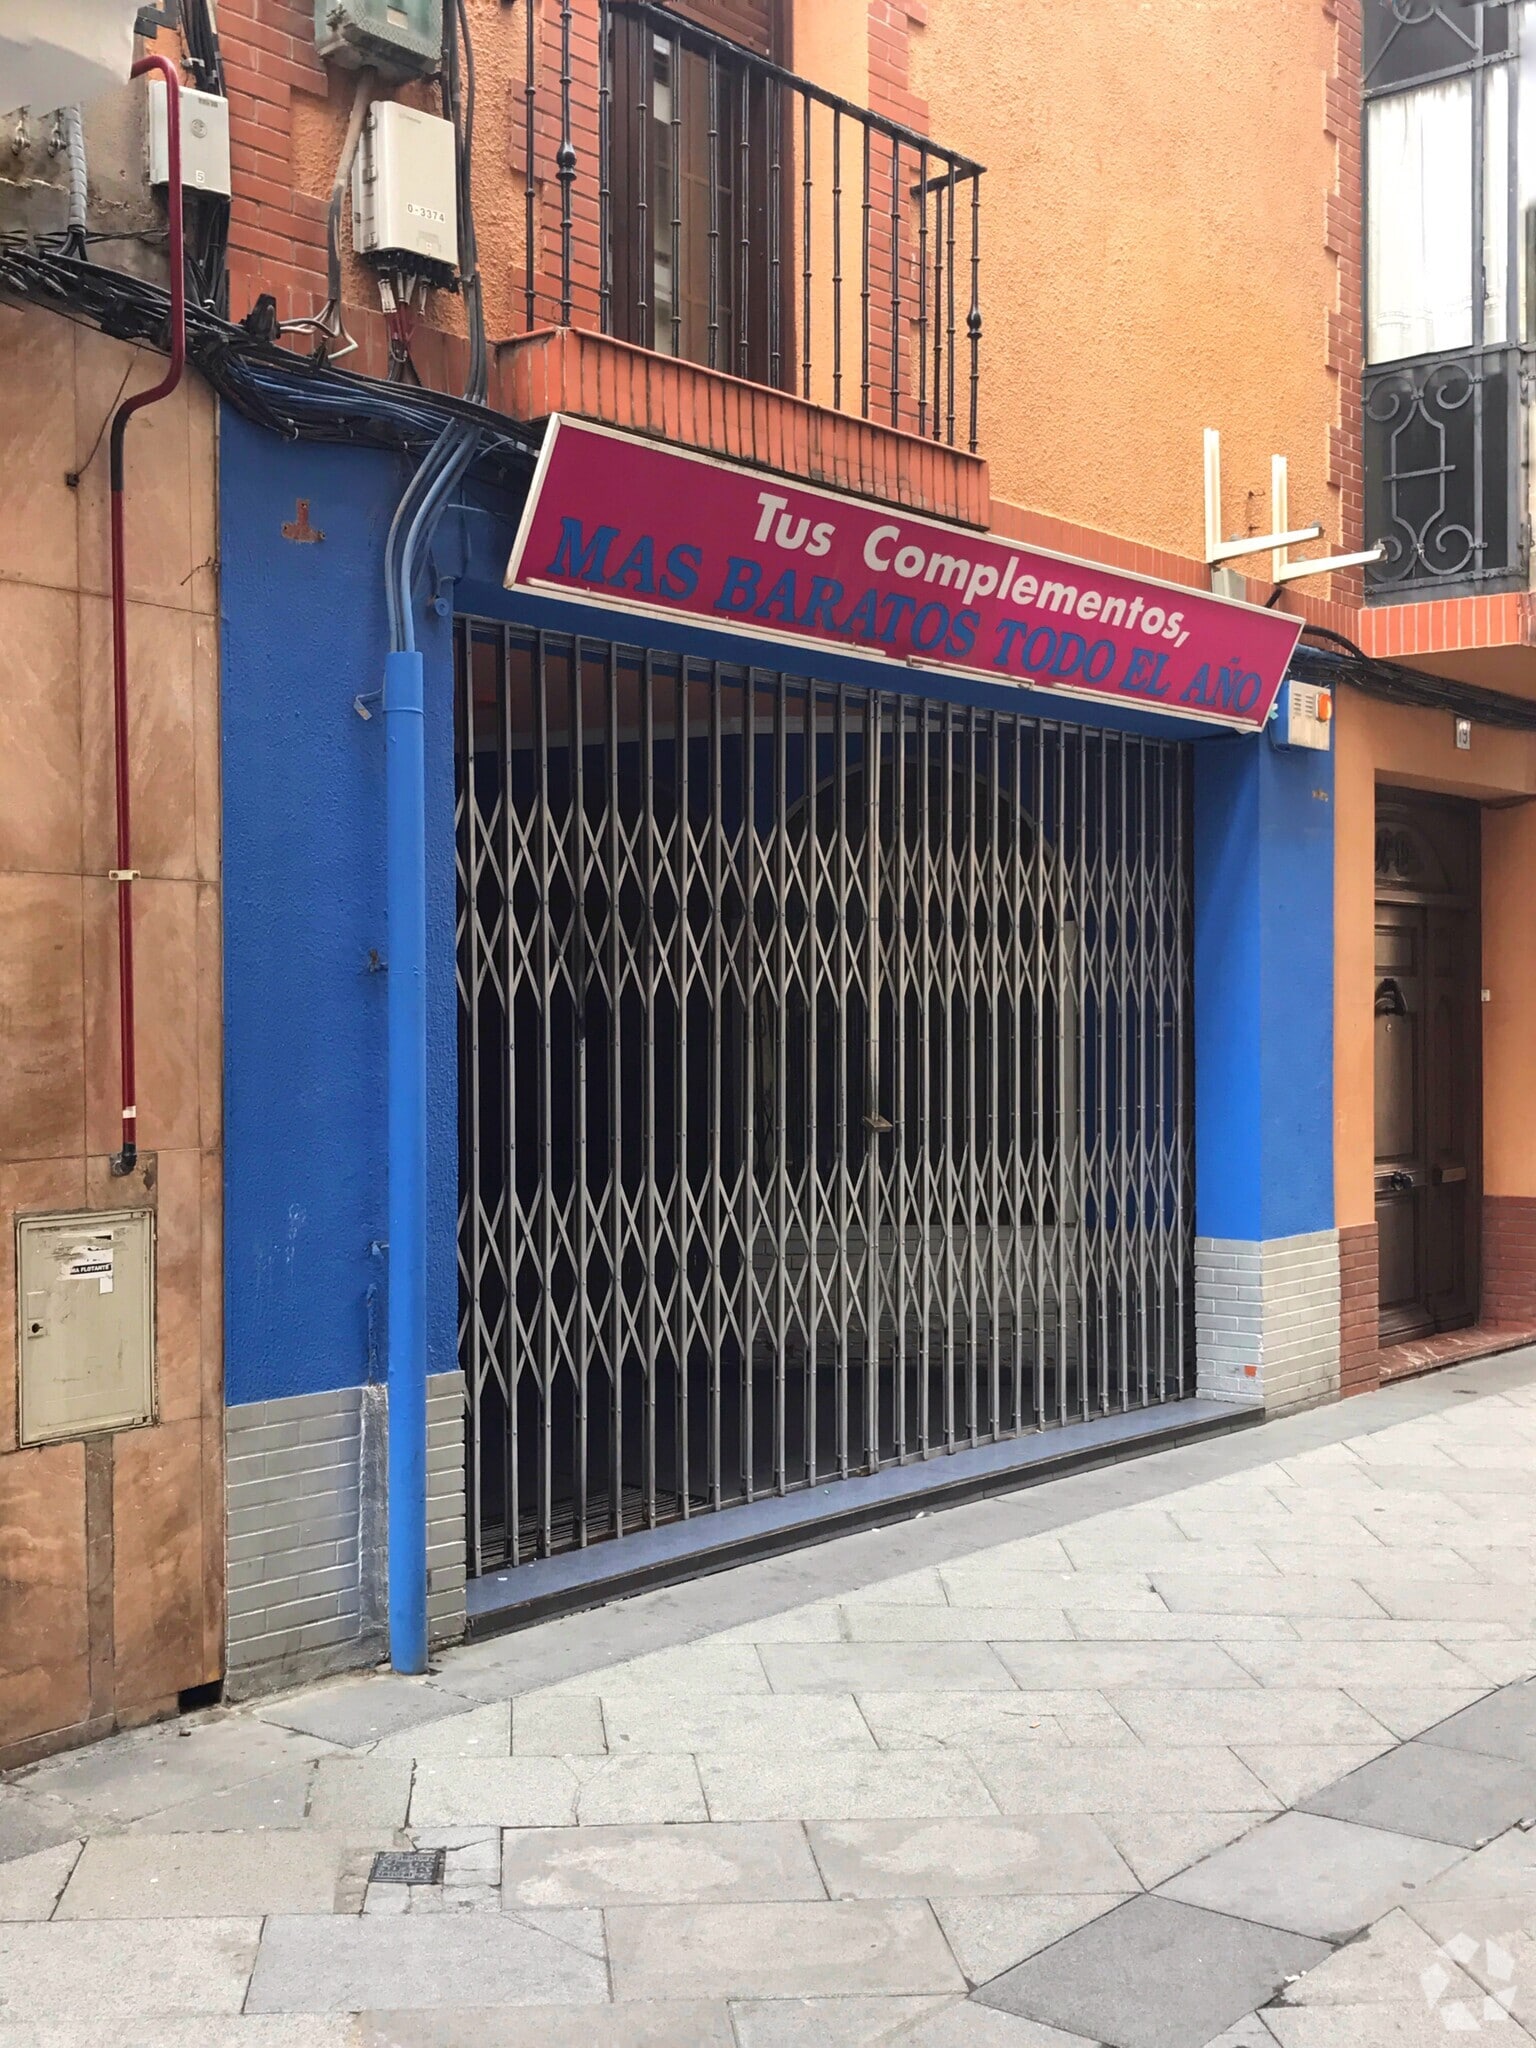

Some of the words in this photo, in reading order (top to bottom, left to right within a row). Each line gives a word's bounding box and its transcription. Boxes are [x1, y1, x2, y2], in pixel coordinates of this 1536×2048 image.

[546, 516, 702, 601] MAS
[713, 556, 980, 657] BARATOS
[993, 619, 1116, 683] TODO
[1120, 647, 1169, 697] EL
[1181, 657, 1261, 713] AÑO
[754, 492, 836, 557] Tus
[863, 525, 1191, 648] Complementos,
